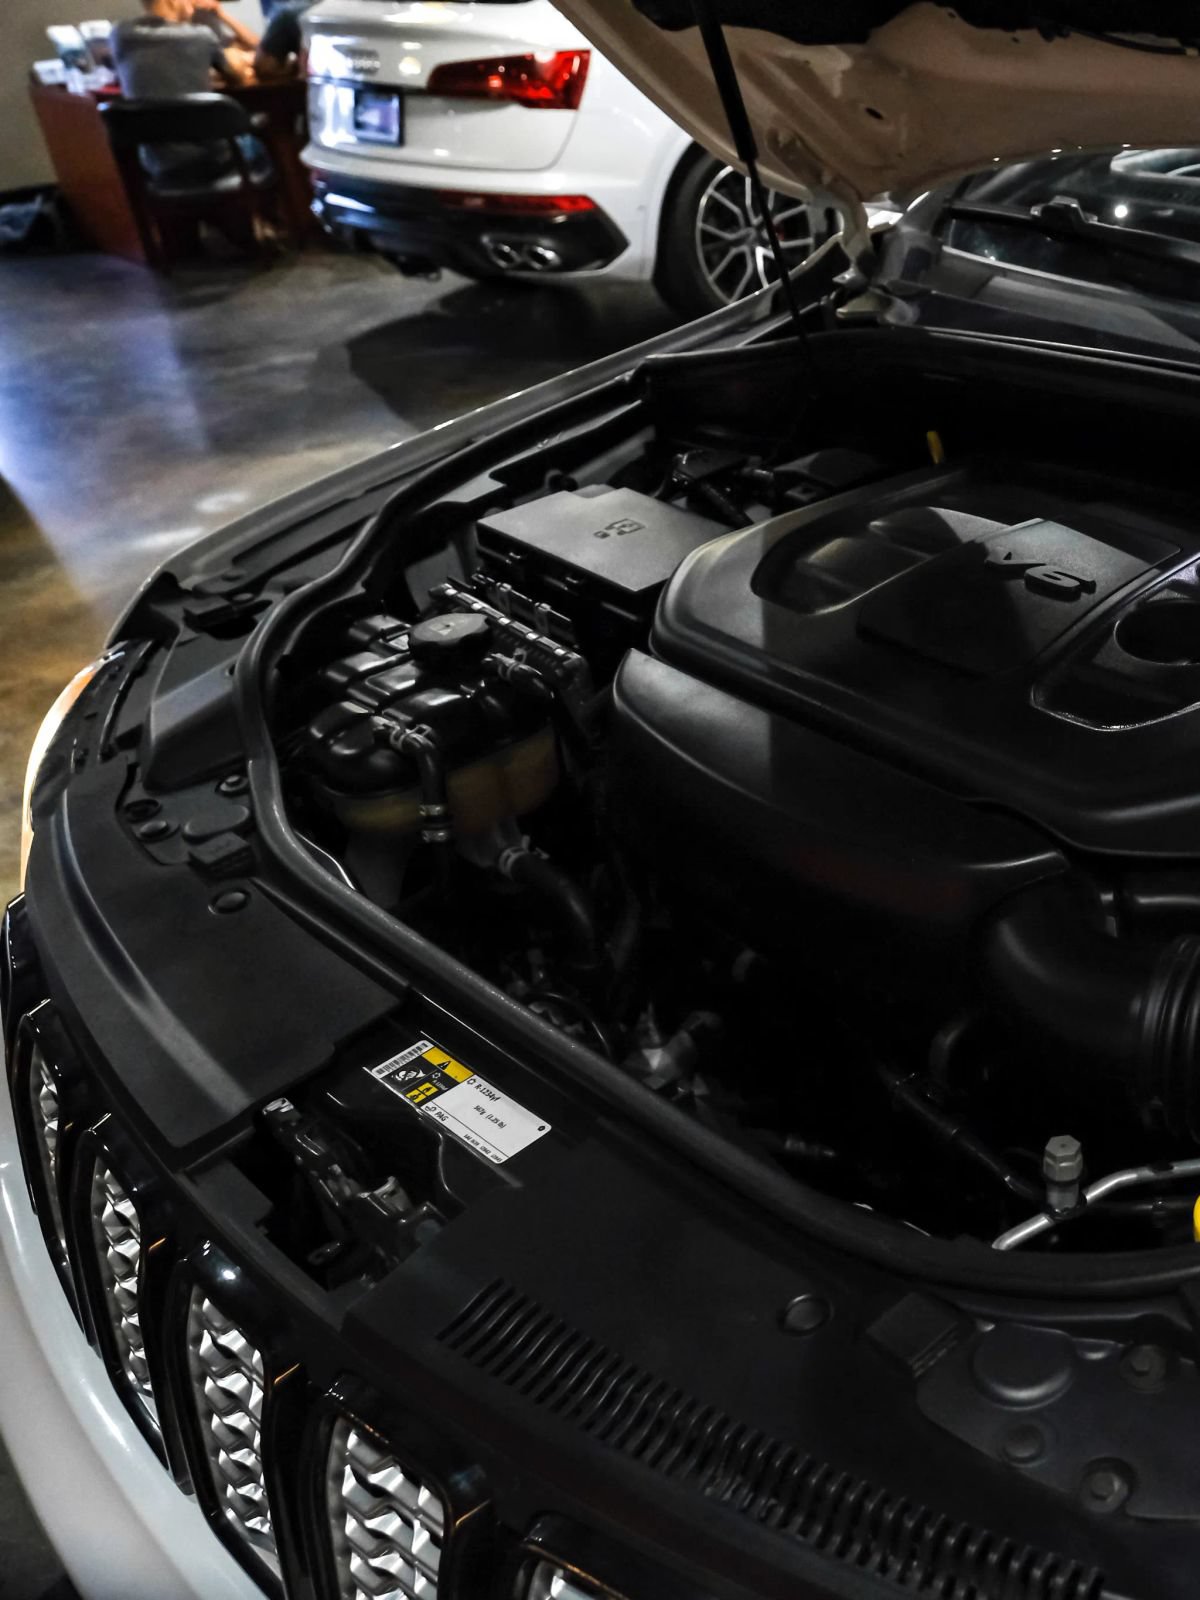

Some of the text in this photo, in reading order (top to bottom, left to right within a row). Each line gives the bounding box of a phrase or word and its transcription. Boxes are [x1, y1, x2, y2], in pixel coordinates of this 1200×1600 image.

[984, 545, 1097, 600] V6
[475, 1084, 501, 1101] R-1234yf
[434, 1111, 449, 1121] PAG
